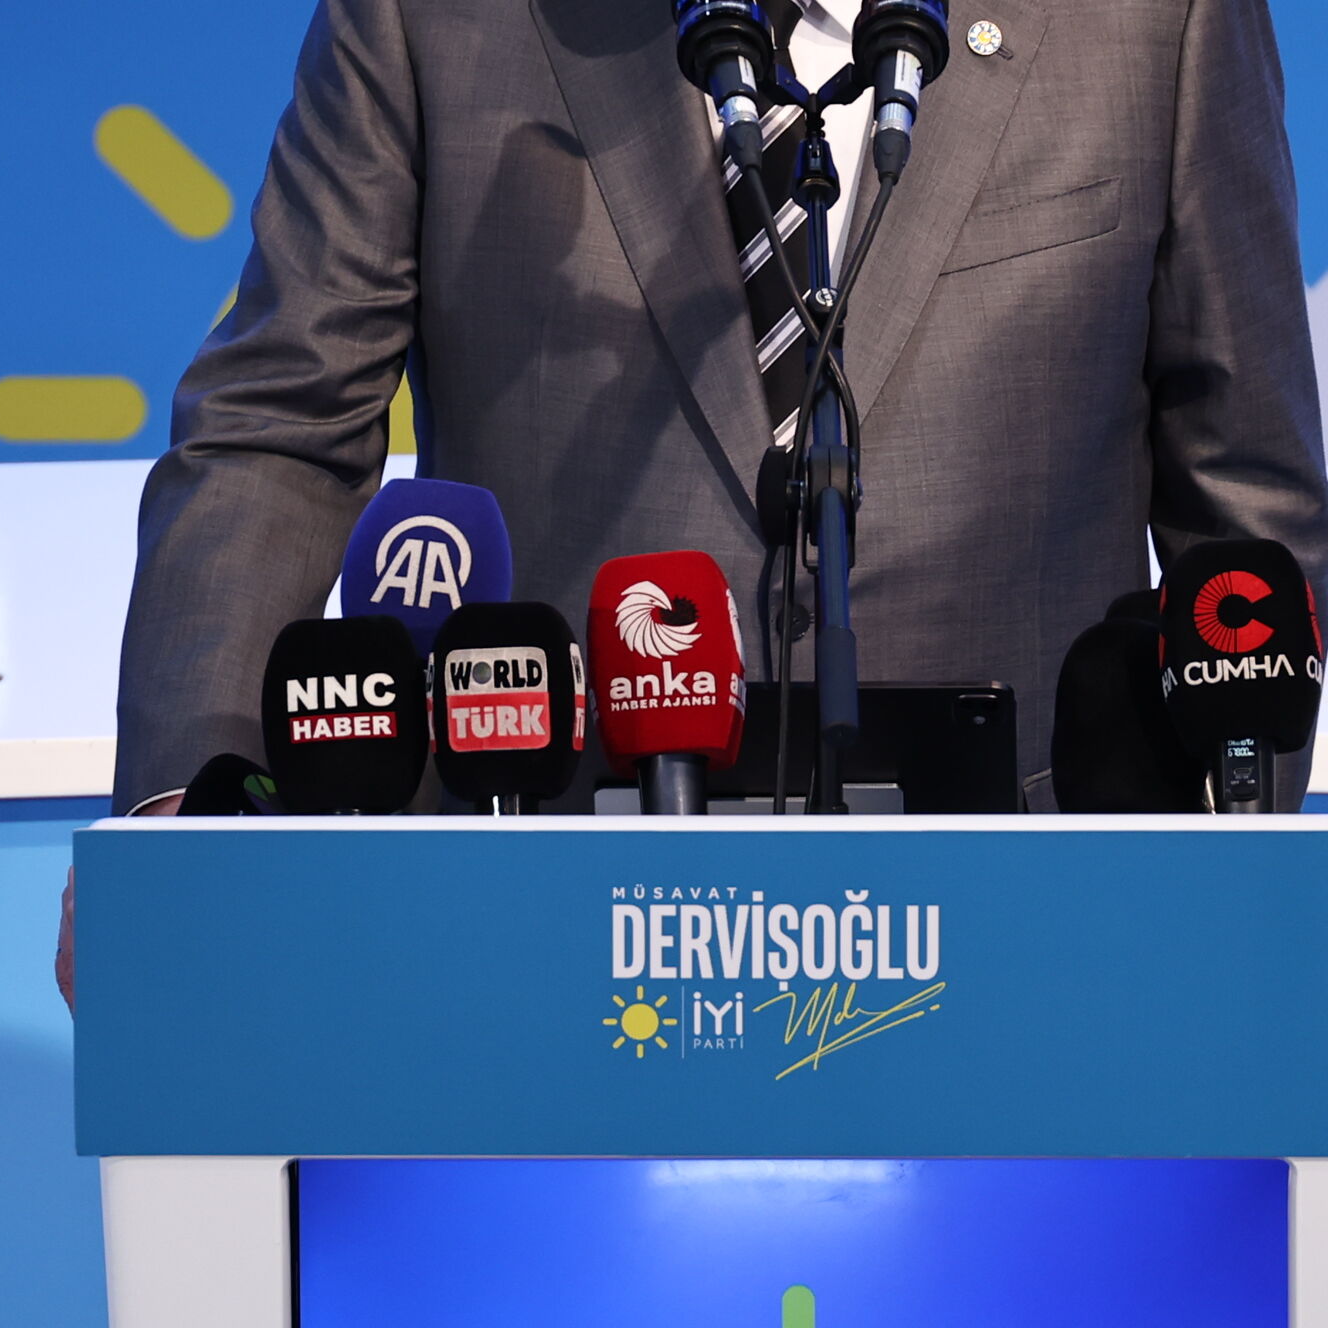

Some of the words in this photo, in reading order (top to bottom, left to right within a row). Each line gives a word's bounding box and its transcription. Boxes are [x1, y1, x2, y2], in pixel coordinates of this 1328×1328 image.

[370, 538, 463, 611] AA
[286, 673, 396, 713] NNC
[609, 661, 717, 701] anka
[451, 704, 546, 739] TÜRK
[610, 698, 659, 712] HABER
[662, 695, 717, 708] AJANSI
[292, 715, 392, 741] HABER
[612, 883, 739, 900] MÜSAVAT
[612, 889, 941, 992] DERVİŞOĞLU
[693, 991, 744, 1036] İYİ
[693, 1036, 744, 1050] PARTİ
